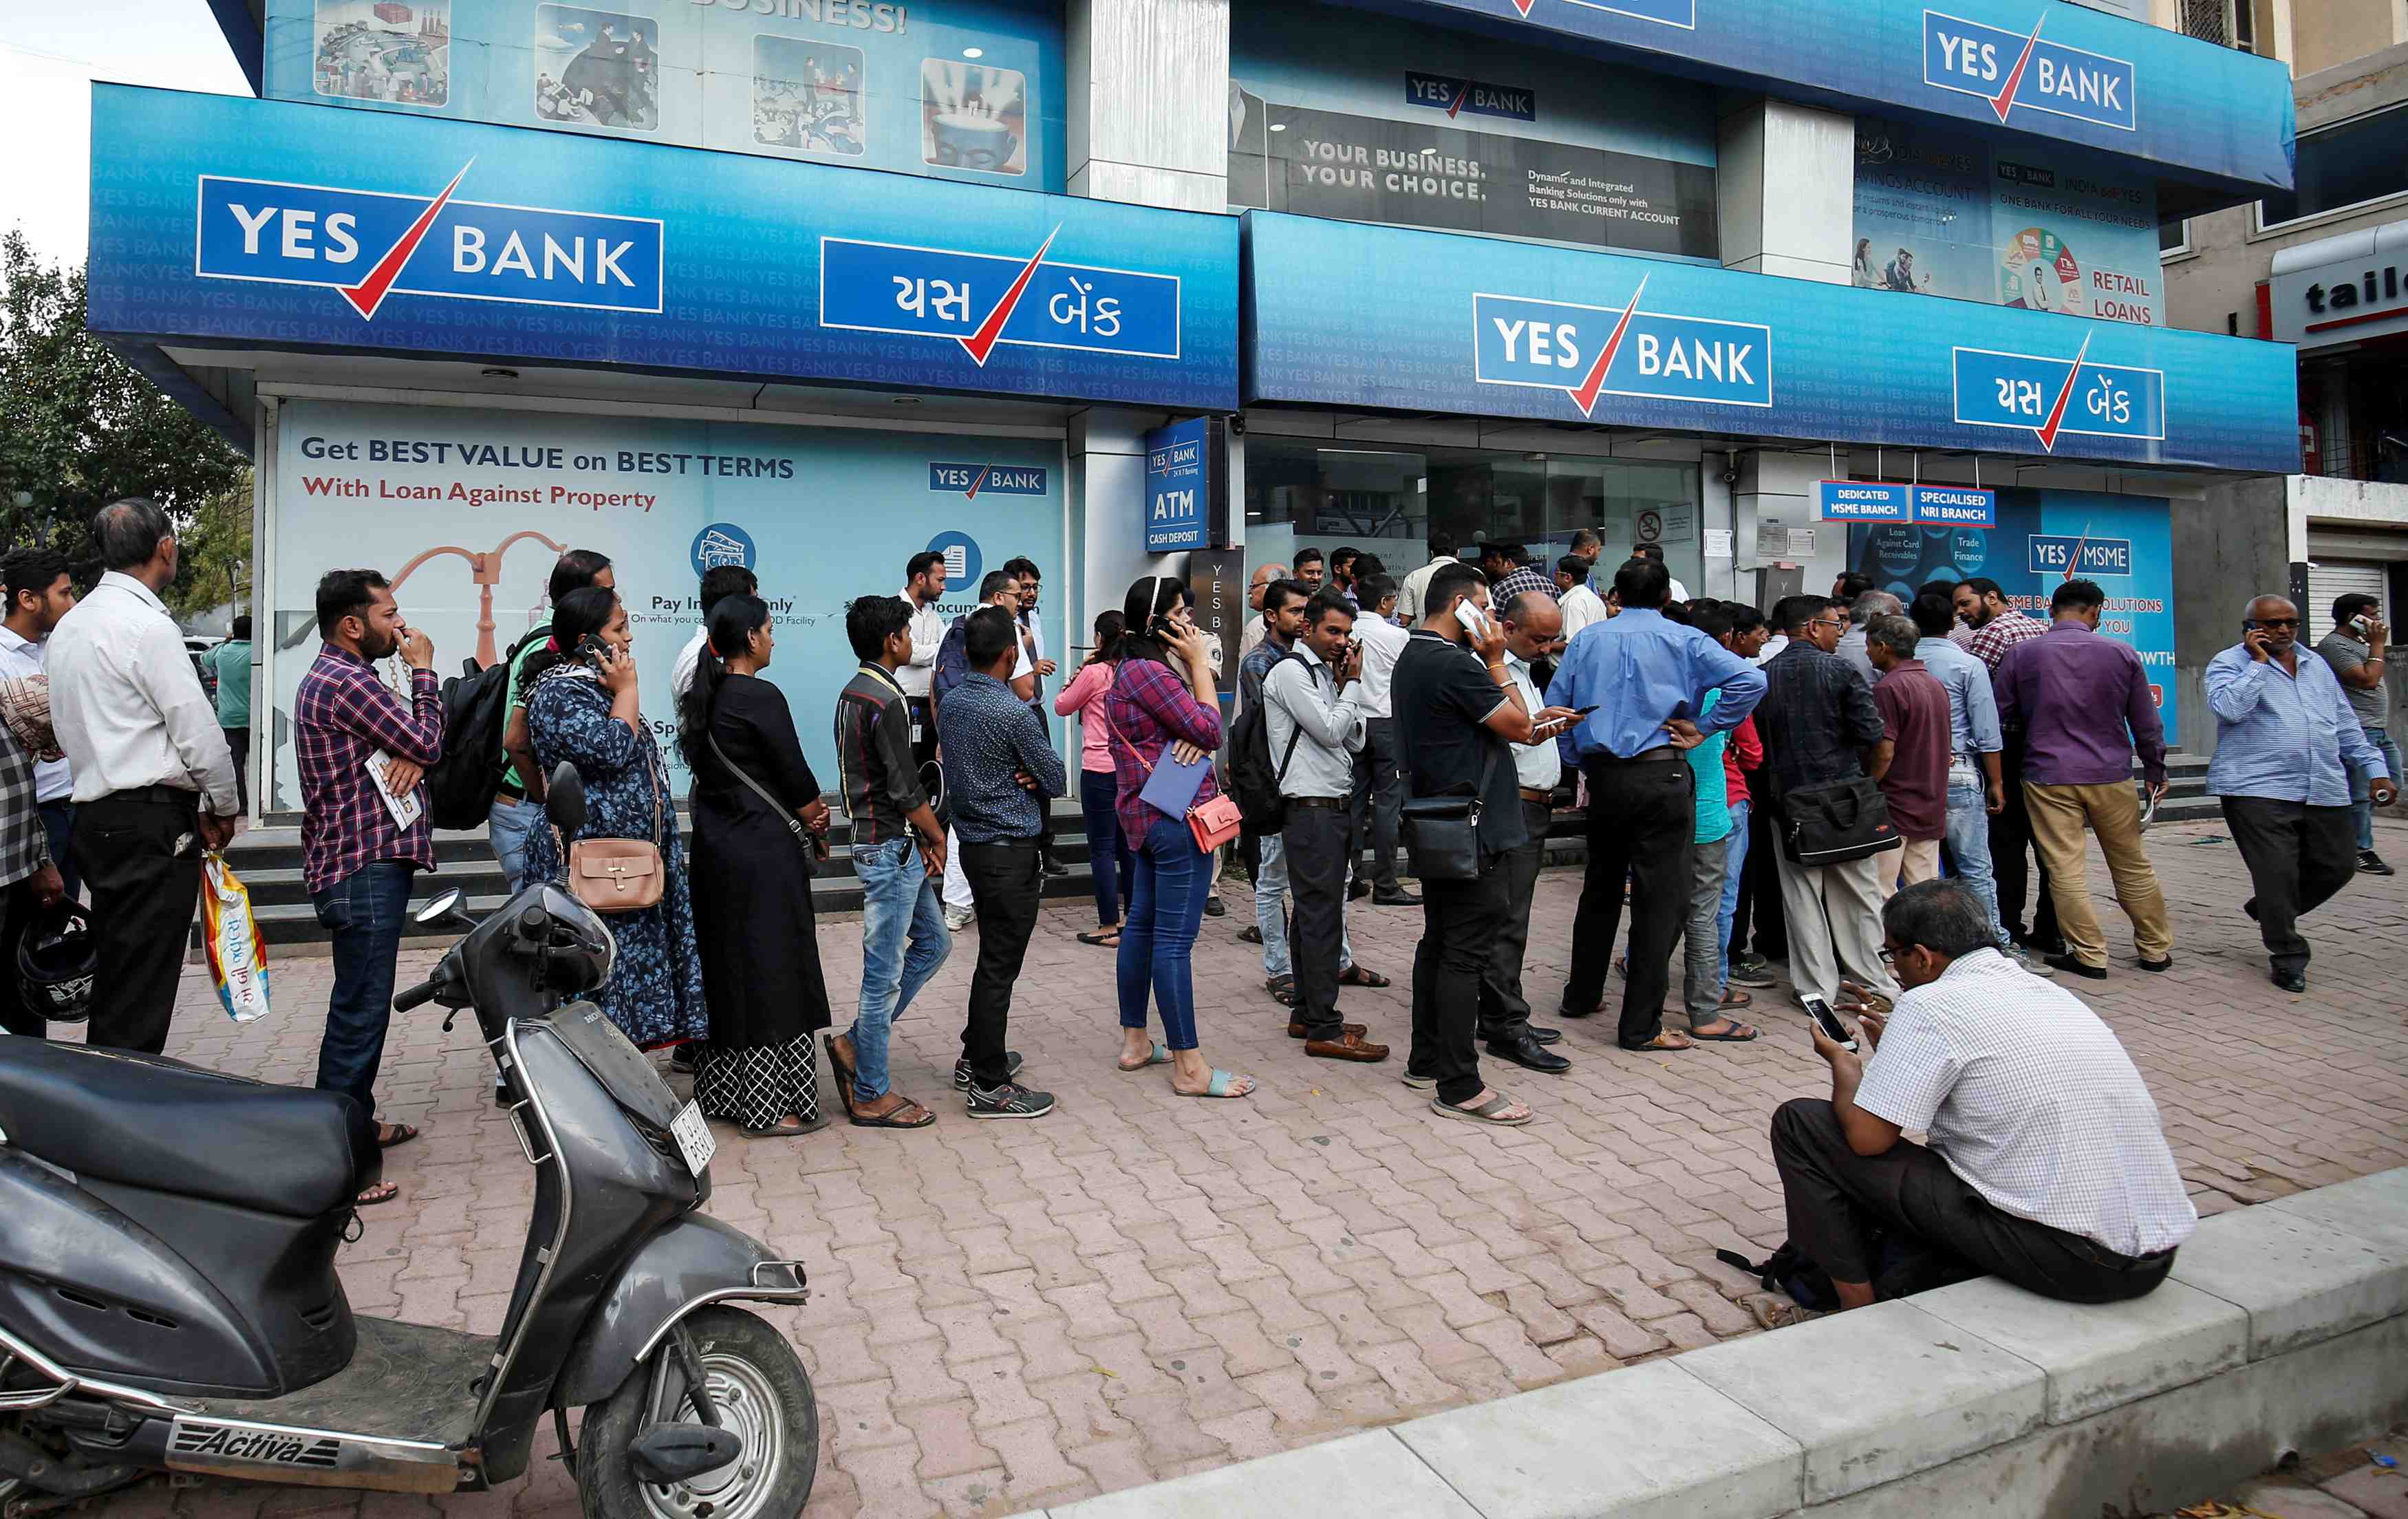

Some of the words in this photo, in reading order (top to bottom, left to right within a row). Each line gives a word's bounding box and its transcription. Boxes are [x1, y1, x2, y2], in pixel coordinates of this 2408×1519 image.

[690, 0, 907, 34] SINESS!
[1937, 32, 1997, 81] YES
[2039, 58, 2123, 111] BANK
[1412, 79, 1450, 101] YES
[1474, 89, 1528, 114] BANK
[1304, 140, 1369, 165] YOUR
[1376, 149, 1487, 180] BUSINESS.
[1302, 164, 1375, 189] YOUR
[1386, 173, 1487, 202] CHOICE.
[1528, 170, 1568, 184] Dynamic
[1569, 176, 1587, 186] and
[1589, 178, 1634, 193] Integrated
[1853, 170, 1901, 189] AVINGS
[1904, 178, 1972, 201] ACCOUNT
[2000, 164, 2017, 177] YES
[2027, 171, 2052, 184] BANK
[1529, 184, 1565, 198] Banking
[1567, 188, 1608, 203] Solutions
[1609, 195, 1627, 208] only
[1629, 199, 1648, 209] with
[1528, 197, 1548, 208] YES
[1550, 200, 1580, 213] BANK
[1581, 204, 1628, 219] CURRENT
[1630, 211, 1681, 226] ACCOUNT
[2000, 193, 2022, 207] ONE
[2024, 197, 2052, 212] BANK
[2054, 204, 2074, 215] FOR
[2074, 208, 2092, 220] ALL
[2093, 211, 2120, 224] YOUR
[2120, 216, 2151, 230] NEEDS
[228, 203, 359, 264] YES
[453, 225, 636, 288] BANK
[2093, 271, 2151, 297] RETAIL
[2305, 266, 2408, 313] tail
[132, 286, 193, 305] BANK
[198, 290, 237, 309] YES
[242, 293, 303, 314] BANK
[307, 297, 343, 318] YES
[893, 275, 970, 323] યસ
[1049, 276, 1121, 337] બેંક
[2094, 299, 2151, 325] LOANS
[153, 313, 191, 331] YES
[198, 315, 259, 336] BANK
[264, 320, 299, 338] YES
[306, 323, 365, 343] BANK
[369, 327, 407, 345] YES
[413, 330, 473, 349] BANK
[473, 335, 506, 354] YES
[512, 338, 563, 356] BANK
[570, 343, 603, 360] YES
[610, 344, 661, 363] BANK
[665, 348, 697, 365] YES
[702, 351, 751, 369] BANK
[755, 355, 787, 373] YES
[791, 358, 838, 376] BANK
[843, 362, 872, 378] YES
[413, 308, 447, 325] YES
[453, 311, 509, 331] BANK
[513, 314, 547, 332] YES
[552, 317, 607, 338] BANK
[611, 322, 644, 341] YES
[649, 325, 699, 344] BANK
[702, 330, 735, 347] YES
[739, 331, 788, 351] BANK
[791, 337, 821, 354] YES
[827, 339, 872, 358] BANK
[879, 345, 905, 362] YES
[910, 346, 955, 365] BANK
[1492, 317, 1580, 369] YES
[1637, 333, 1754, 386] BANK
[991, 354, 1033, 372] BANK
[1038, 357, 1064, 374] YES
[1068, 360, 1108, 378] BANK
[1112, 364, 1139, 381] YES
[1143, 367, 1182, 385] BANK
[1185, 371, 1210, 387] YES
[1287, 369, 1311, 383] YES
[1314, 371, 1350, 387] BANK
[1353, 374, 1377, 387] YES
[1379, 376, 1414, 390] BANK
[1417, 378, 1438, 392] YES
[1441, 380, 1476, 396] BANK
[1995, 377, 2042, 416] યસ
[2087, 374, 2130, 424] બેંક
[300, 436, 358, 462] Get
[368, 439, 453, 464] BEST
[456, 443, 563, 470] VALUE
[572, 453, 606, 471] on
[617, 451, 692, 475] BEST
[697, 455, 794, 480] TERMS
[1152, 453, 1165, 467] YES
[1174, 447, 1195, 463] BANK
[935, 468, 969, 486] YES
[991, 471, 1040, 489] BANK
[301, 476, 369, 499] With
[379, 479, 441, 500] Loan
[447, 482, 542, 507] Against
[550, 486, 656, 513] Property
[1154, 489, 1194, 520] ATM
[1838, 489, 1889, 500] DEDICATED
[1920, 491, 1986, 506] SPECIALISED
[1831, 504, 1858, 514] MSME
[1860, 504, 1898, 515] BRANCH
[1920, 506, 1939, 517] NRI
[1942, 508, 1986, 521] BRANCH
[1150, 534, 1168, 544] CASH
[1169, 530, 1198, 543] DEPOSIT
[1876, 539, 1902, 549] Against
[1903, 540, 1920, 549] Card
[1889, 528, 1906, 537] Loan
[1957, 537, 1979, 548] Trade
[1879, 551, 1917, 560] Receivables
[1954, 551, 1983, 561] Finance
[2036, 544, 2066, 565] YES
[2084, 546, 2127, 567] MSME
[652, 596, 682, 614] Pay
[770, 598, 793, 614] nly
[2008, 595, 2032, 610] SME
[2104, 598, 2163, 612] OLUTIONS
[631, 614, 645, 623] On
[649, 614, 671, 623] what
[674, 616, 692, 625] you
[786, 616, 815, 627] Facility
[196, 1428, 305, 1463] Activa
